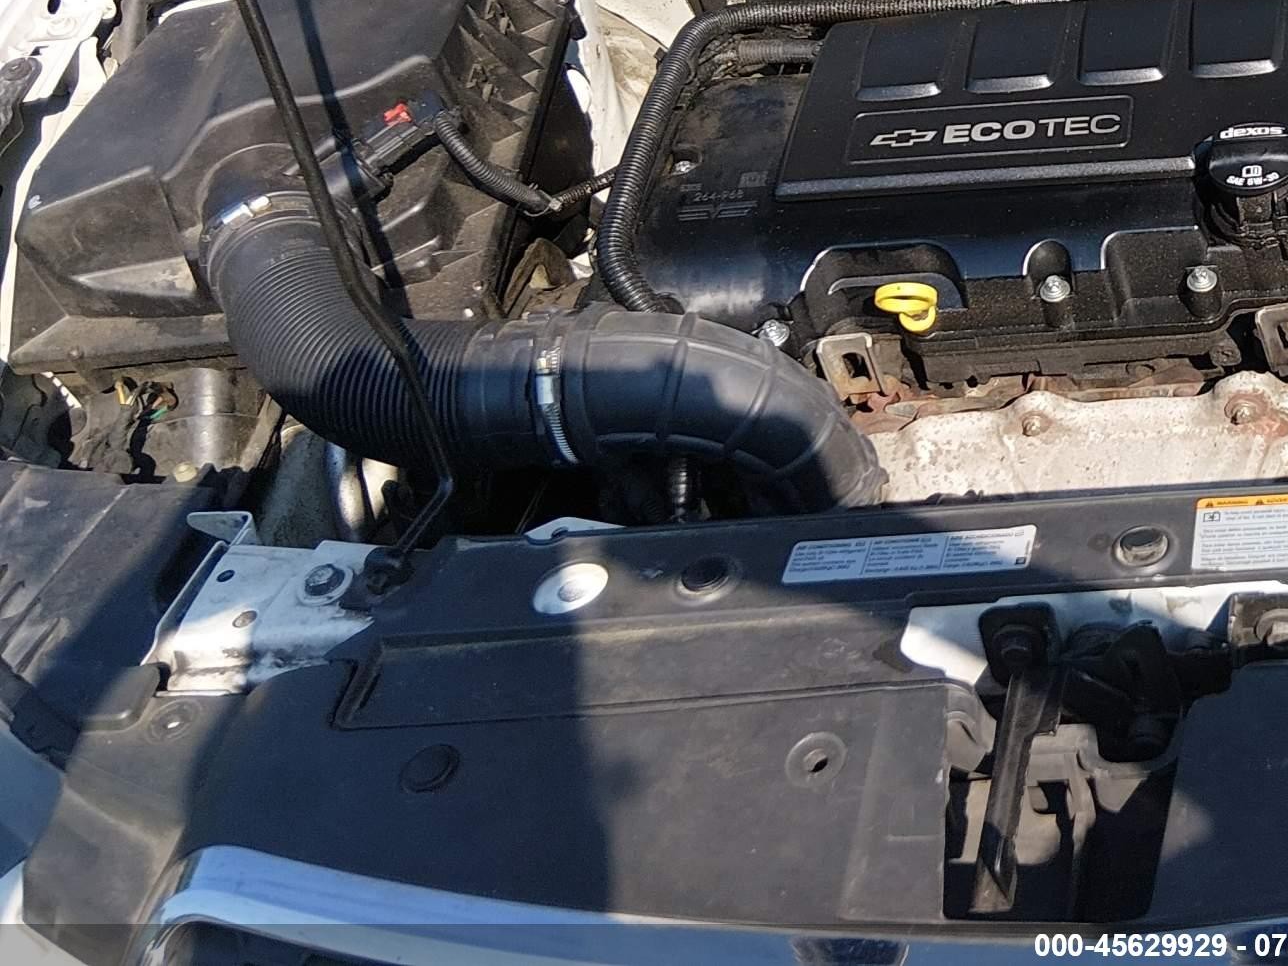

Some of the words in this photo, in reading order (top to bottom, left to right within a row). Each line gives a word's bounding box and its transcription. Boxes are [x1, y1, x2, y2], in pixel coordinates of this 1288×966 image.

[943, 114, 1121, 144] ECOTEC
[1219, 126, 1285, 140] dexos
[1226, 175, 1246, 186] SAE
